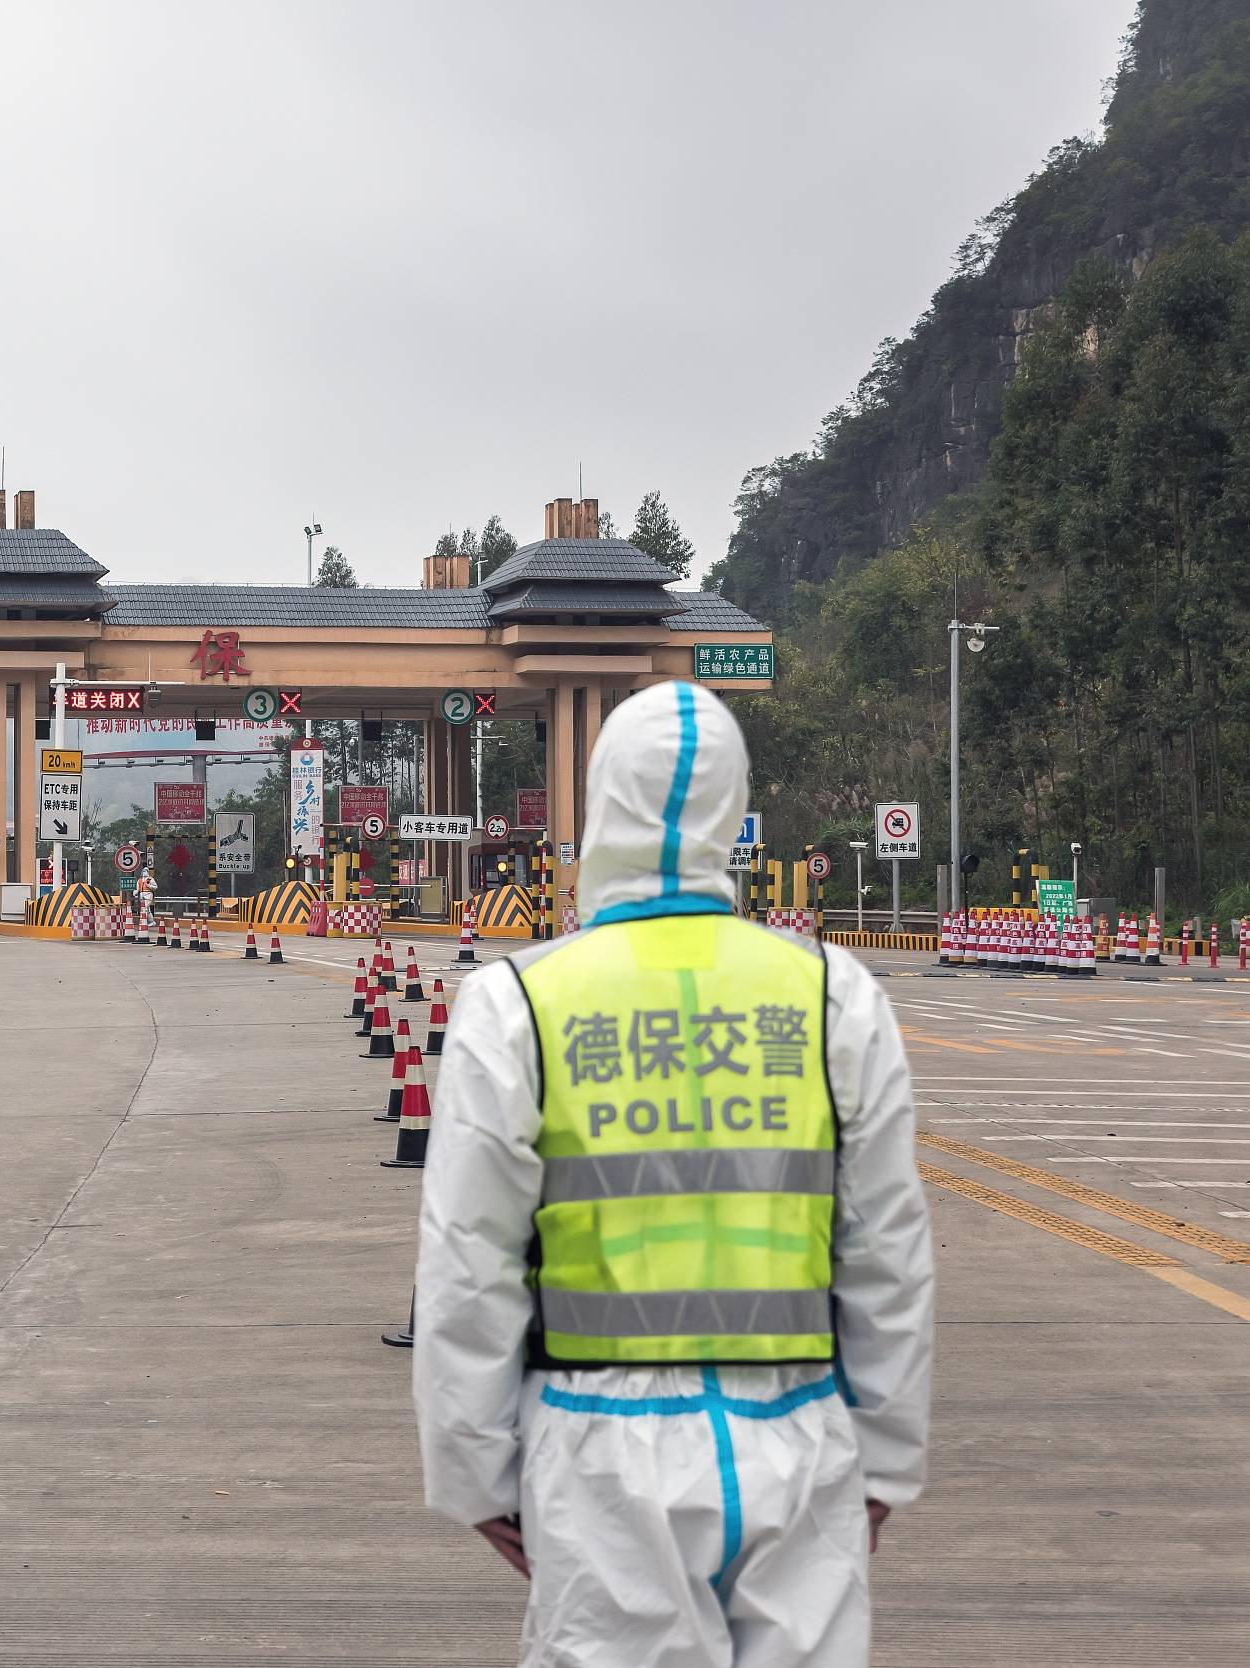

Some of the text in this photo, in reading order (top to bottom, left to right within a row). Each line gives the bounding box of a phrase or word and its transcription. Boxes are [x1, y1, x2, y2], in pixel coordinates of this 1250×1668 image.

[190, 630, 253, 681] 保
[699, 648, 769, 661] 鲜活农产品
[699, 662, 770, 675] 运输绿色通道
[253, 695, 267, 714] 3
[451, 697, 464, 717] 2
[49, 755, 61, 767] 20
[44, 783, 78, 795] ETC专用
[44, 800, 78, 811] 保持车距
[370, 820, 379, 833] 5
[403, 821, 469, 835] 小客车专用道
[880, 843, 917, 853] 左侧车道
[123, 852, 133, 866] 5
[219, 853, 251, 861] 系安全带
[814, 859, 824, 873] 5
[562, 1004, 809, 1087] 德保交警
[588, 1095, 789, 1138] POLICE
